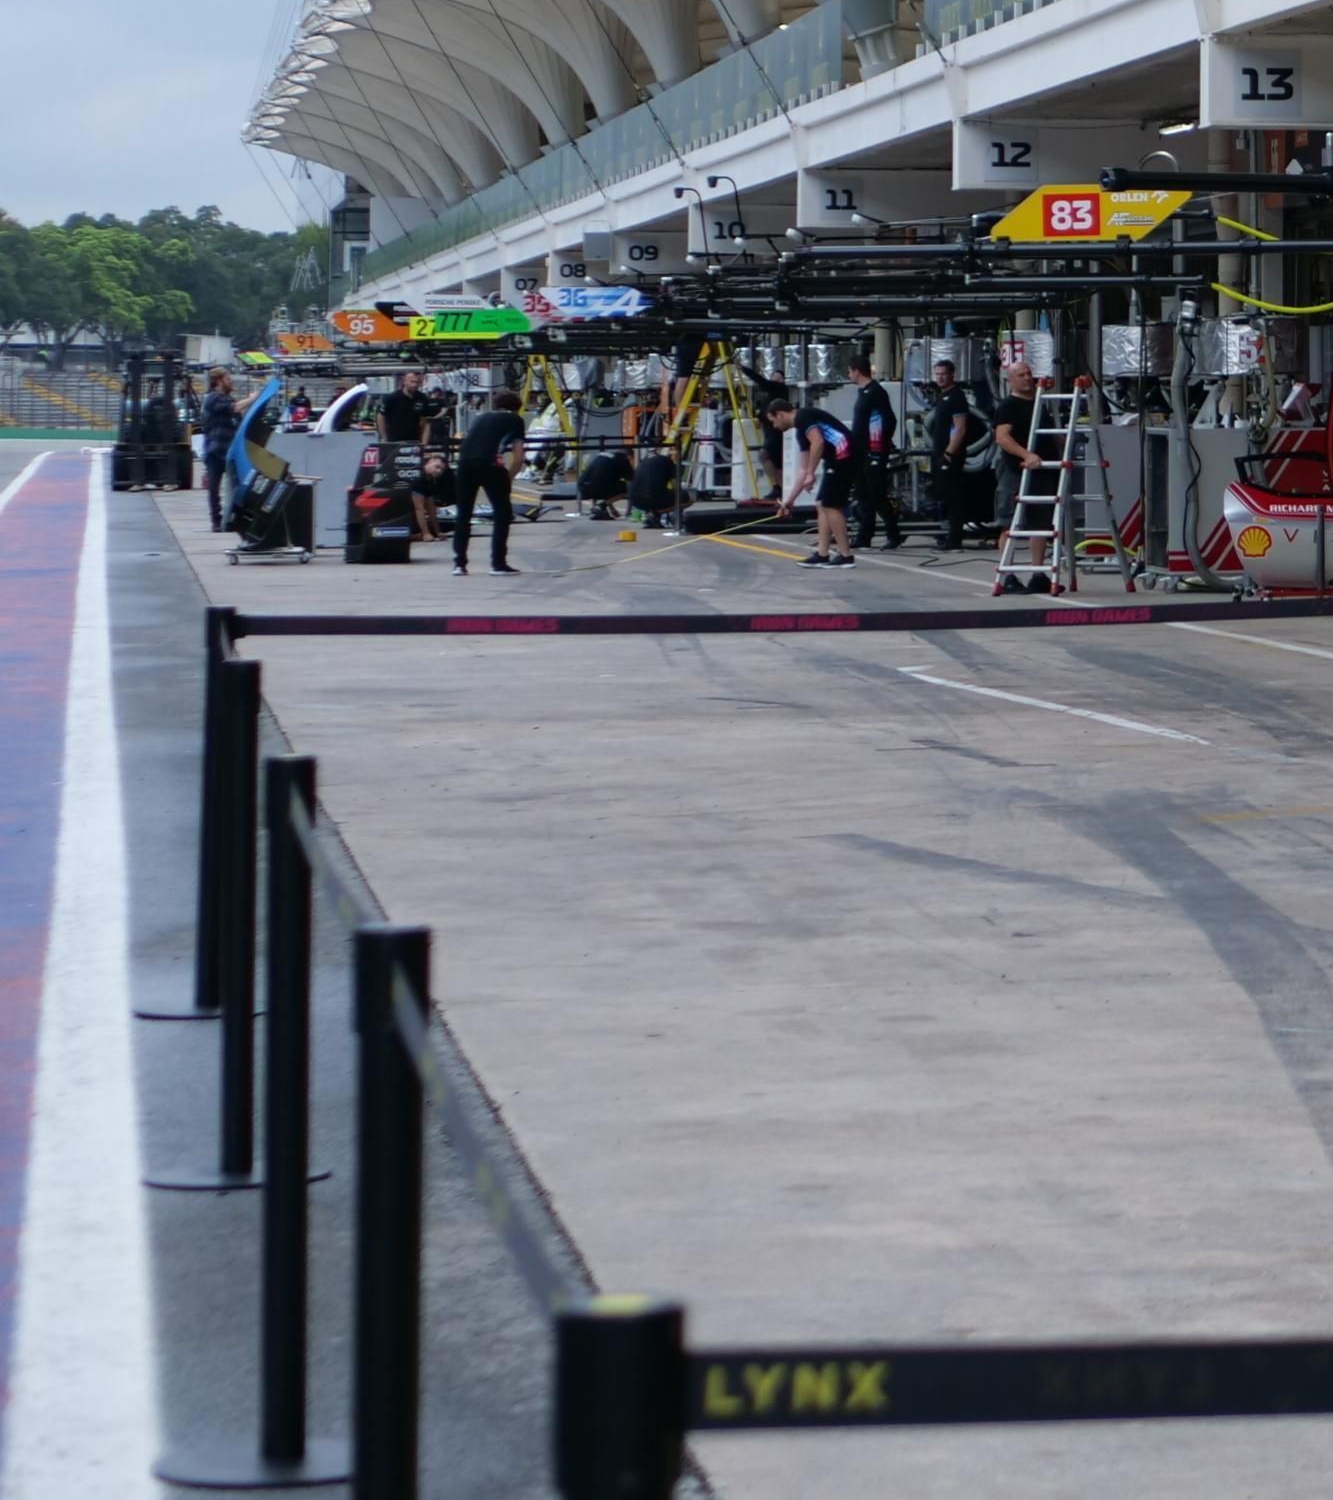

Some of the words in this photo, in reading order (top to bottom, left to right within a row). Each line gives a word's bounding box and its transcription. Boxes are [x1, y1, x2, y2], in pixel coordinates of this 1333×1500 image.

[1241, 67, 1294, 101] 13
[991, 142, 1032, 167] 12
[825, 189, 857, 210] 11
[1110, 192, 1148, 203] ORLEN
[1051, 200, 1093, 230] 83
[714, 221, 745, 239] 10
[628, 245, 659, 261] 09
[560, 264, 586, 278] 08
[515, 278, 538, 291] 07
[559, 288, 589, 307] 36
[350, 319, 375, 335] 95
[437, 312, 473, 332] 777
[297, 335, 315, 348] 91
[1045, 609, 1089, 626] IRON
[1091, 607, 1152, 624] DAMES
[701, 1358, 892, 1418] LYNX
